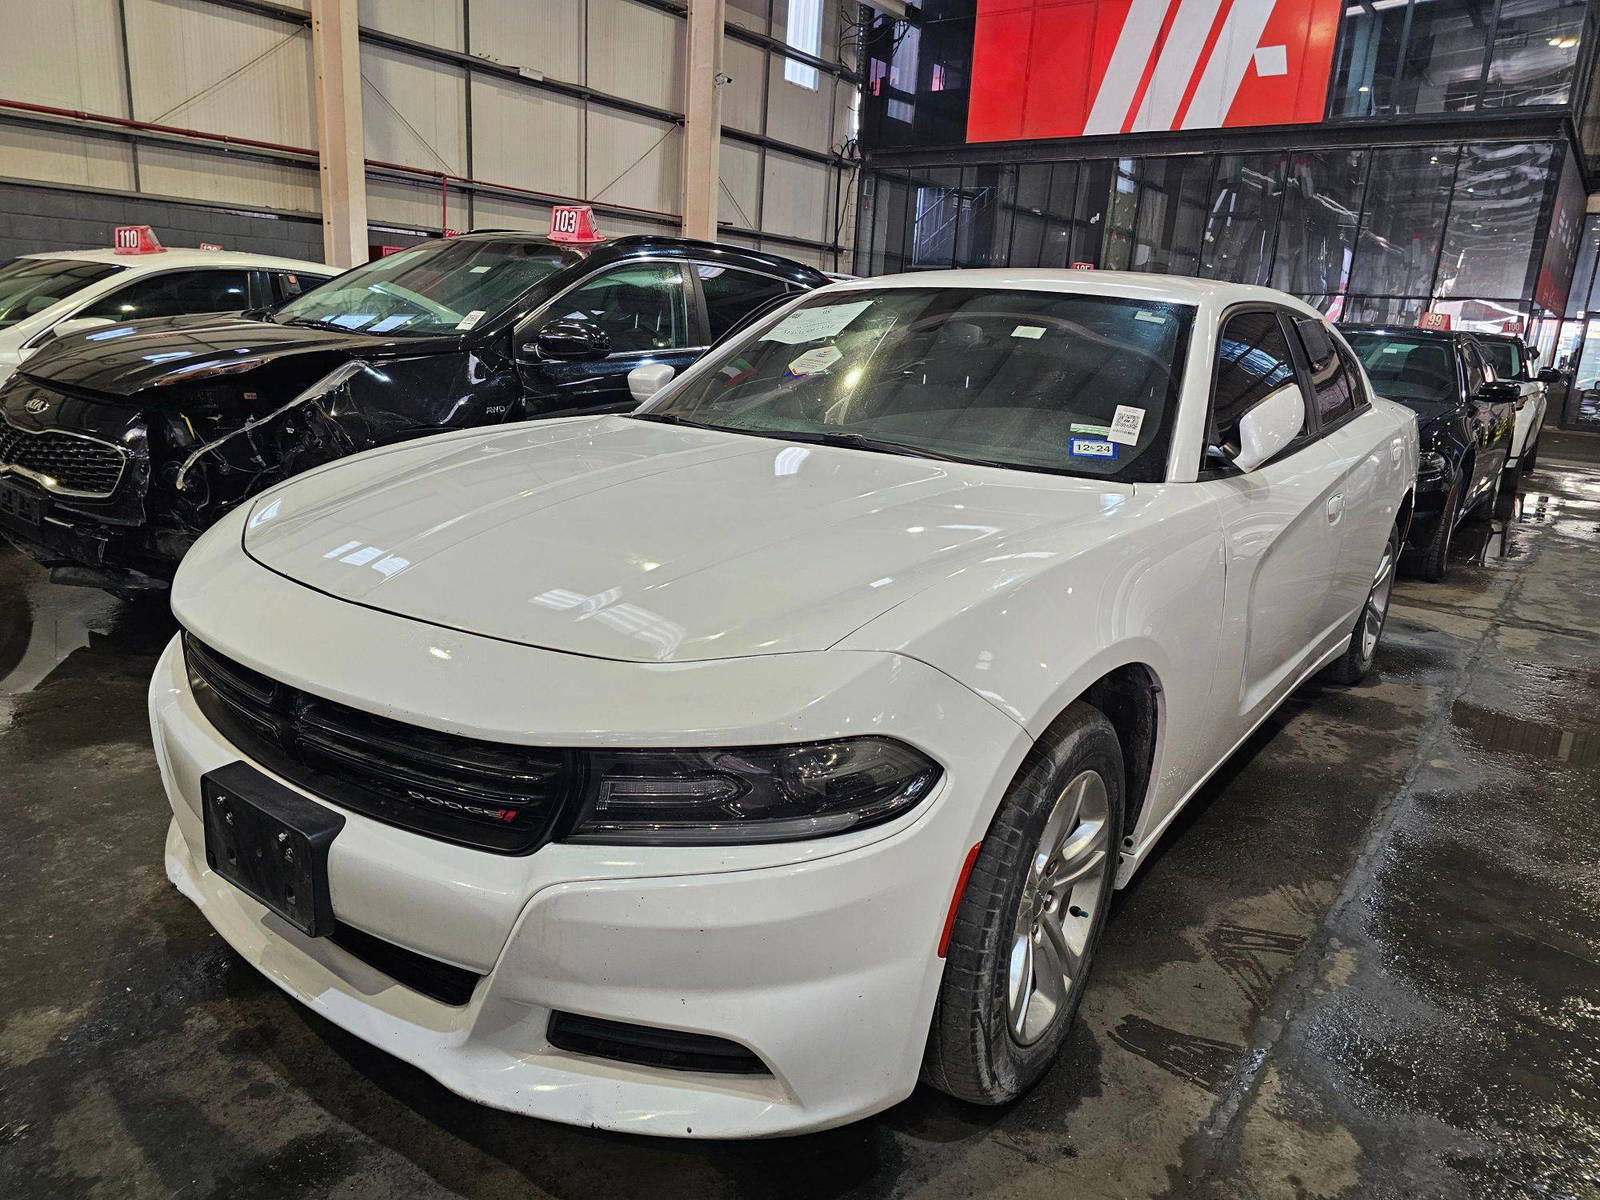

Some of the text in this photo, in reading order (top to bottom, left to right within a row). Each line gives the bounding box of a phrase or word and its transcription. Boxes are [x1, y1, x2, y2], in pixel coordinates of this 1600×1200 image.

[555, 210, 577, 233] 103
[119, 230, 138, 248] 110
[1427, 314, 1442, 326] 99
[25, 398, 46, 411] KIA
[485, 405, 506, 414] AWD
[408, 790, 504, 819] DODGE
